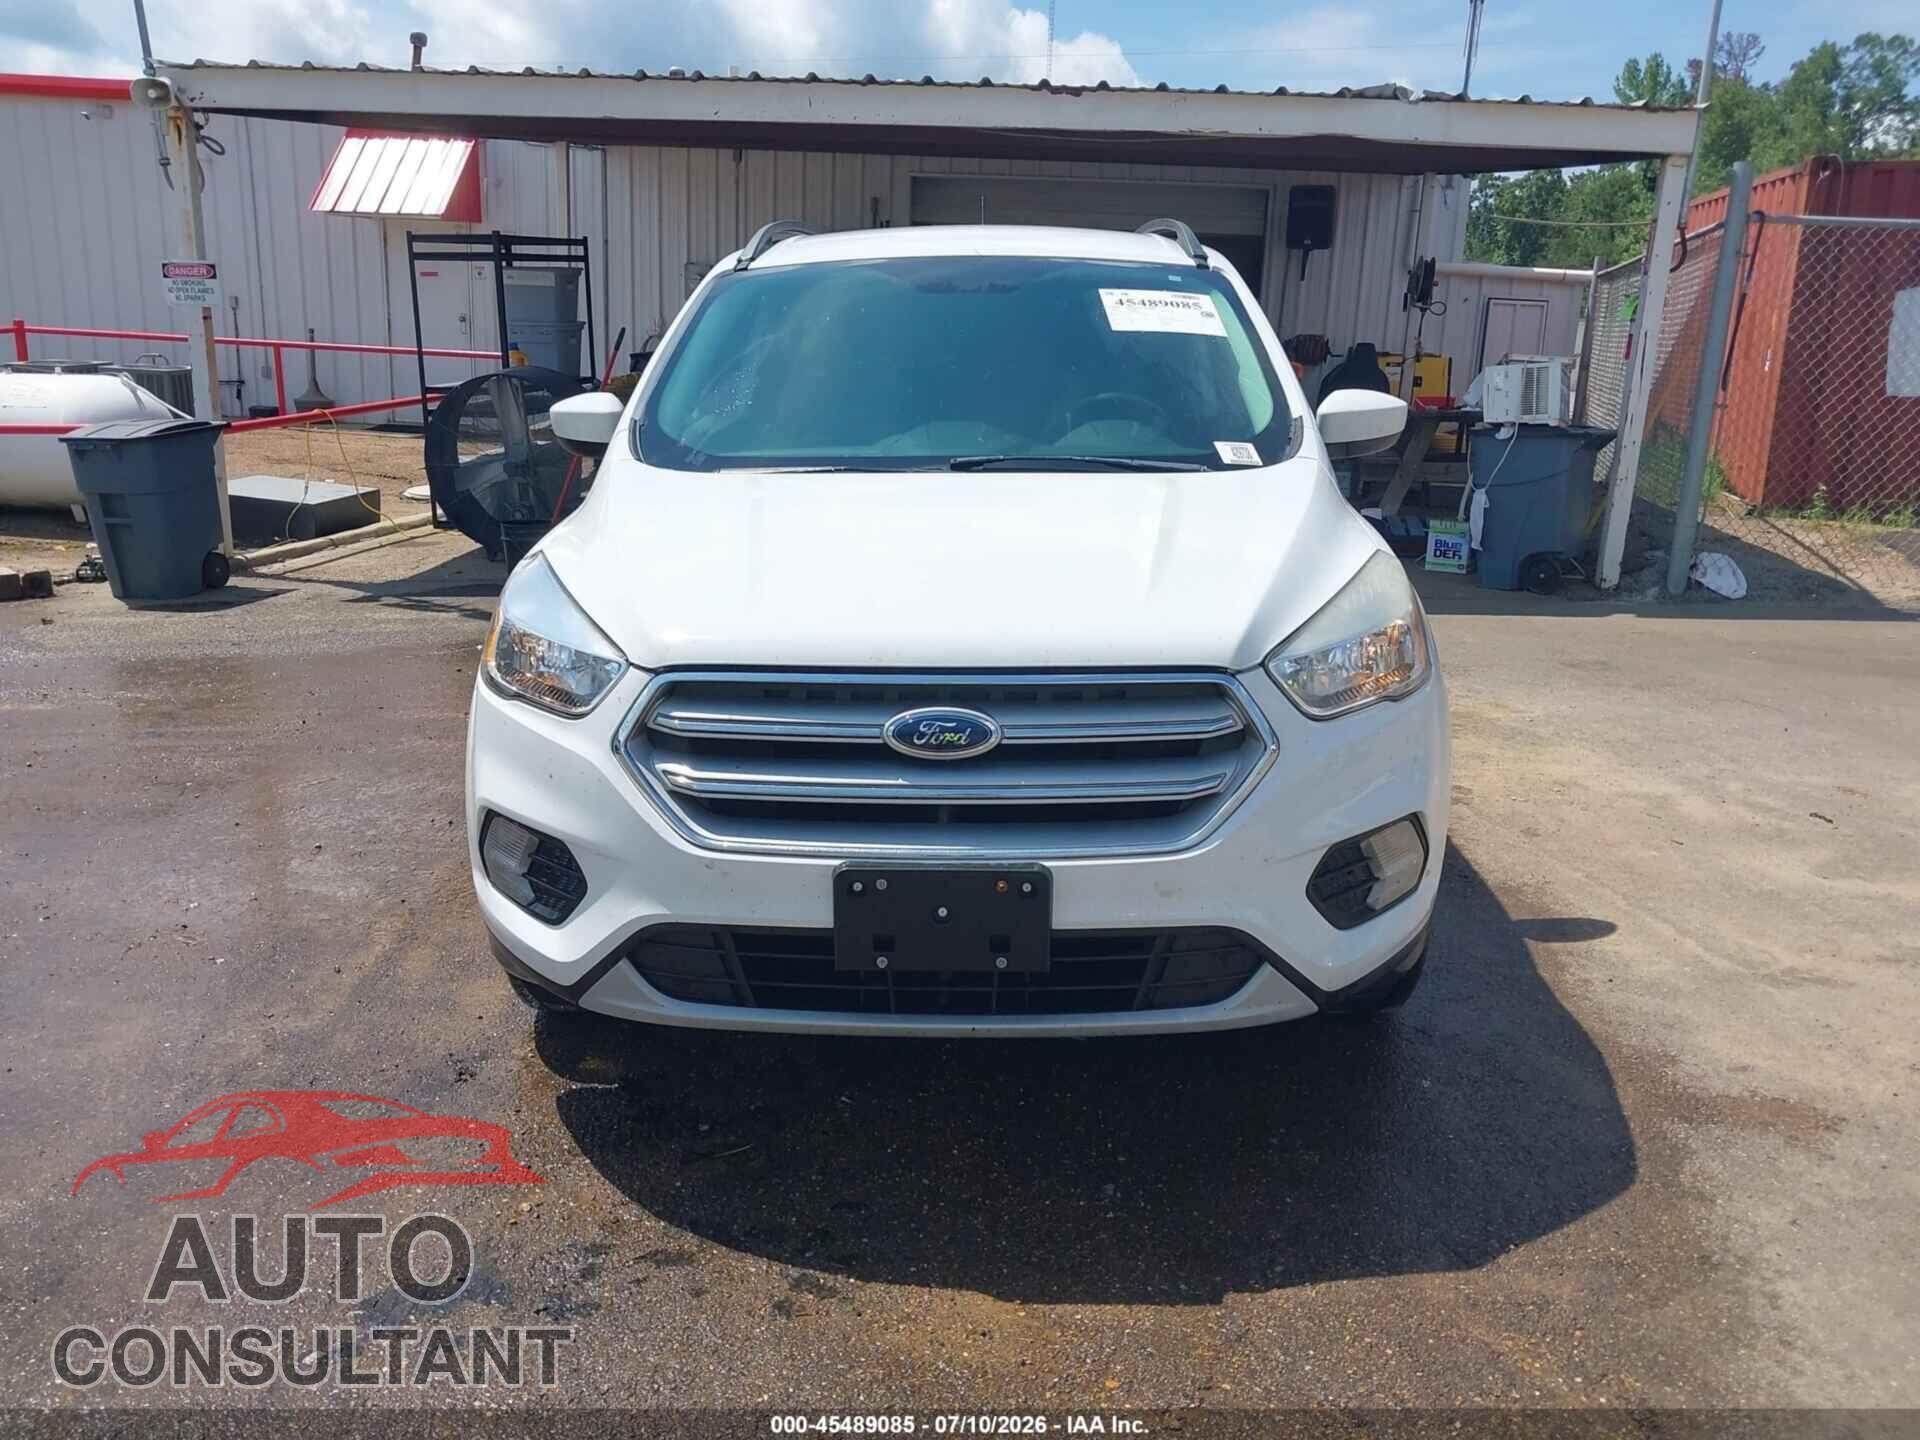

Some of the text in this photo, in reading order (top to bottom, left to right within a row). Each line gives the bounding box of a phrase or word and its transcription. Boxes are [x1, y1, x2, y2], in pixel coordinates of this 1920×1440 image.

[168, 266, 207, 275] DANGER
[1114, 297, 1203, 311] 45489085
[1434, 538, 1465, 550] Blue
[913, 720, 972, 745] Ford
